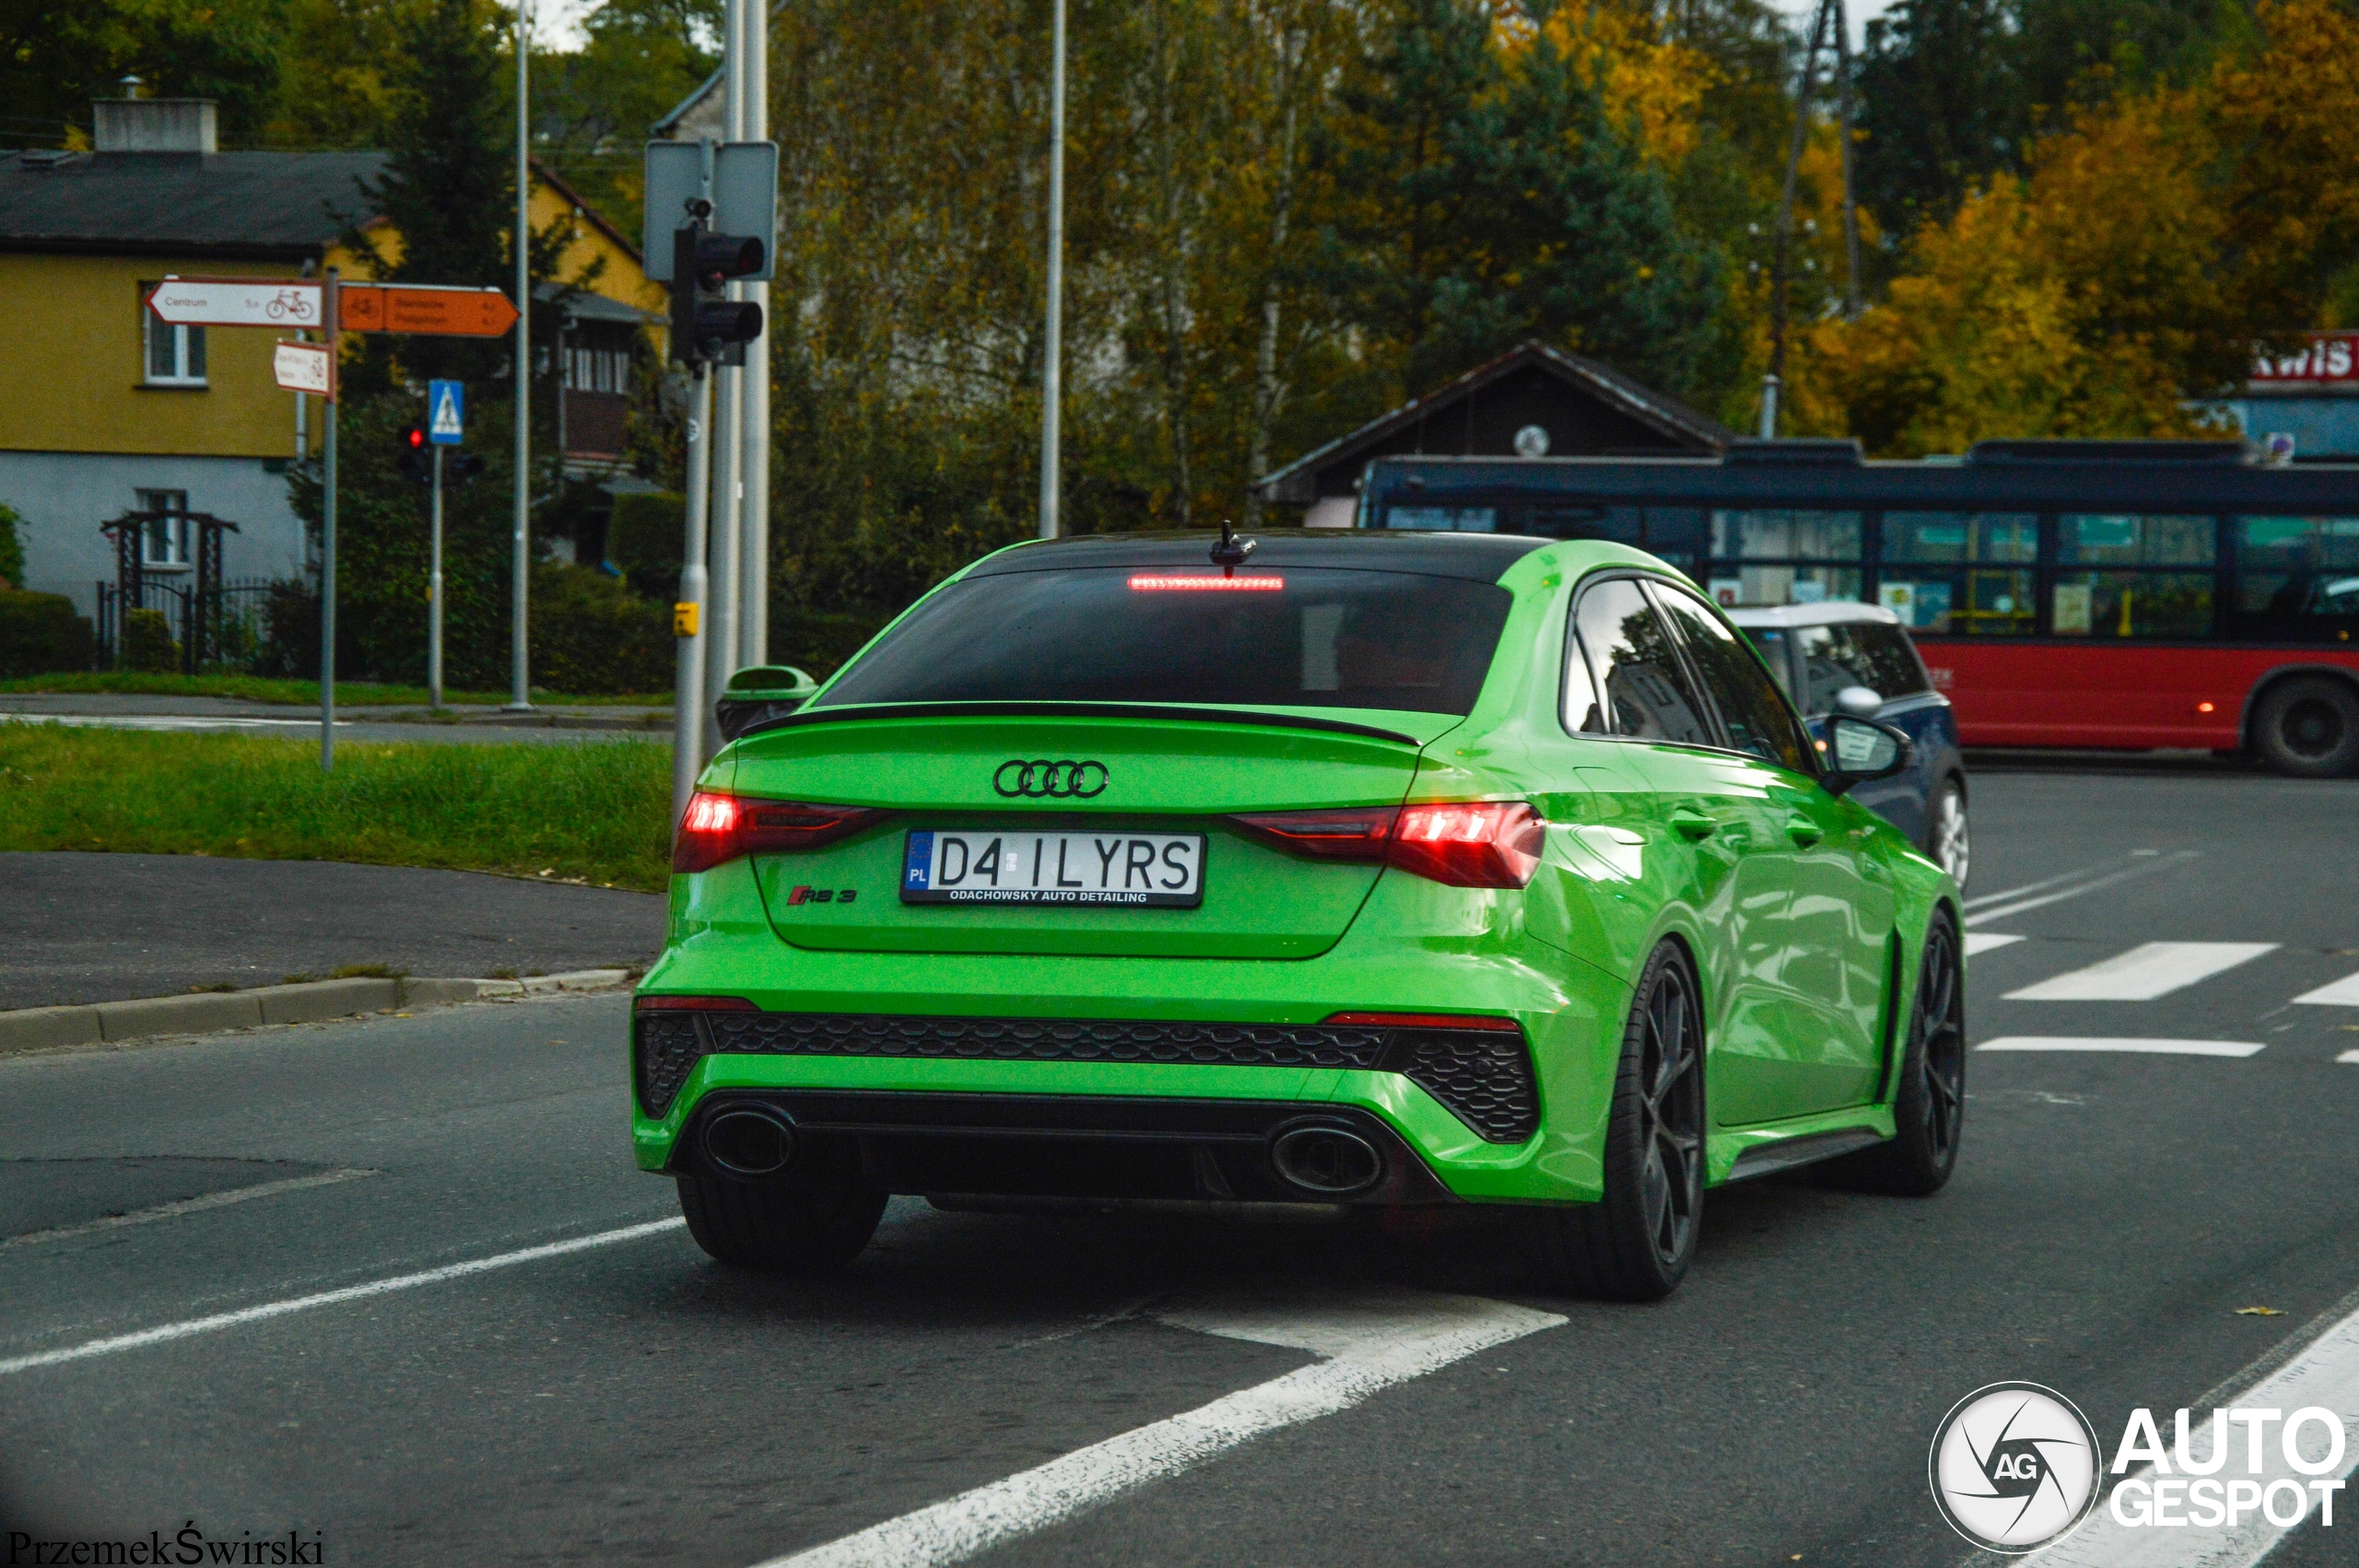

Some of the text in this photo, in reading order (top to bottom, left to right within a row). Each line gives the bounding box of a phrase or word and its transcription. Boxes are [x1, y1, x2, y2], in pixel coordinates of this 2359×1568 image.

[164, 296, 207, 307] Centrum
[938, 837, 1191, 889] D4 ILYRS
[910, 869, 926, 882] PL
[793, 888, 858, 903] RS 3
[949, 890, 1147, 903] ODACHOWSKY AUTO DETAILING
